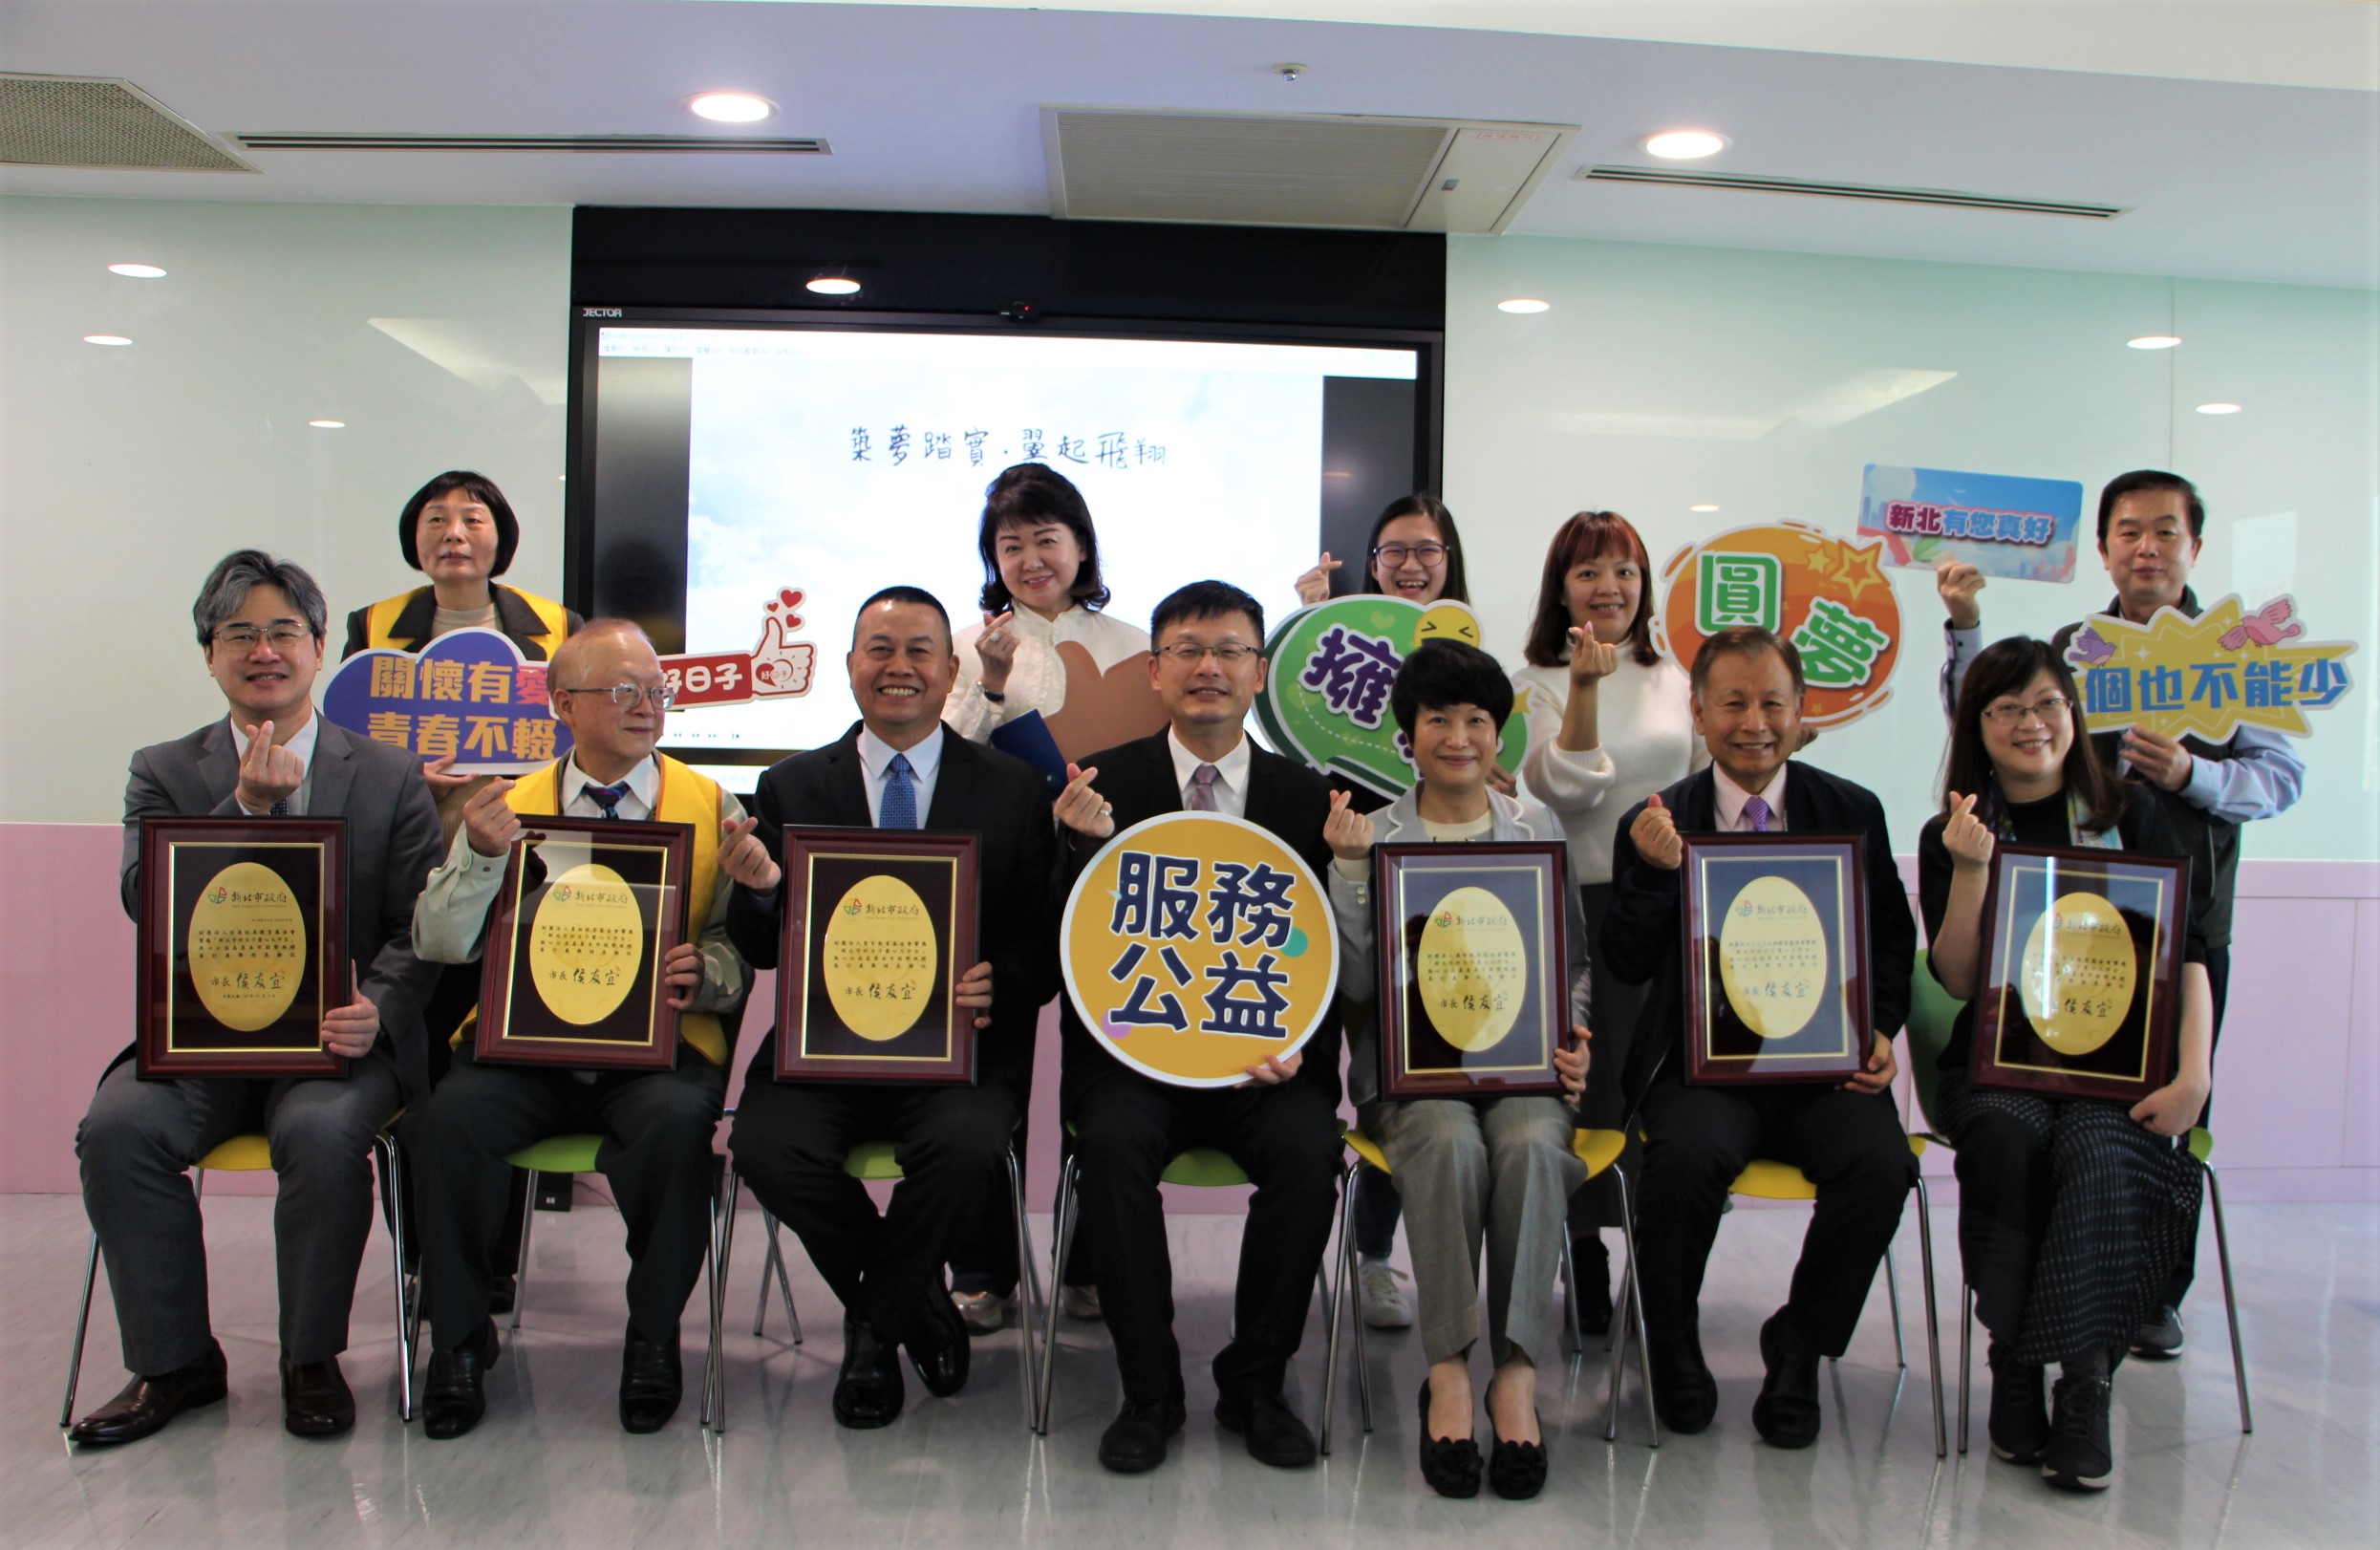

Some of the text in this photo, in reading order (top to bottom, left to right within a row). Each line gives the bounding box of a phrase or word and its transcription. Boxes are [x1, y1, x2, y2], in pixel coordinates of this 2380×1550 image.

[583, 308, 622, 317] JECTOR
[1888, 503, 2052, 545] 新北有您真好
[370, 656, 550, 706] 關懷有愛
[2085, 658, 2348, 713] 個也不能少
[367, 711, 558, 761] 青春不輟
[231, 891, 288, 904] 新北市政府
[575, 890, 629, 904] 新北市政府
[866, 904, 919, 915] 新北市政府
[1109, 851, 1297, 949] 服務
[1108, 941, 1290, 1040] 公益
